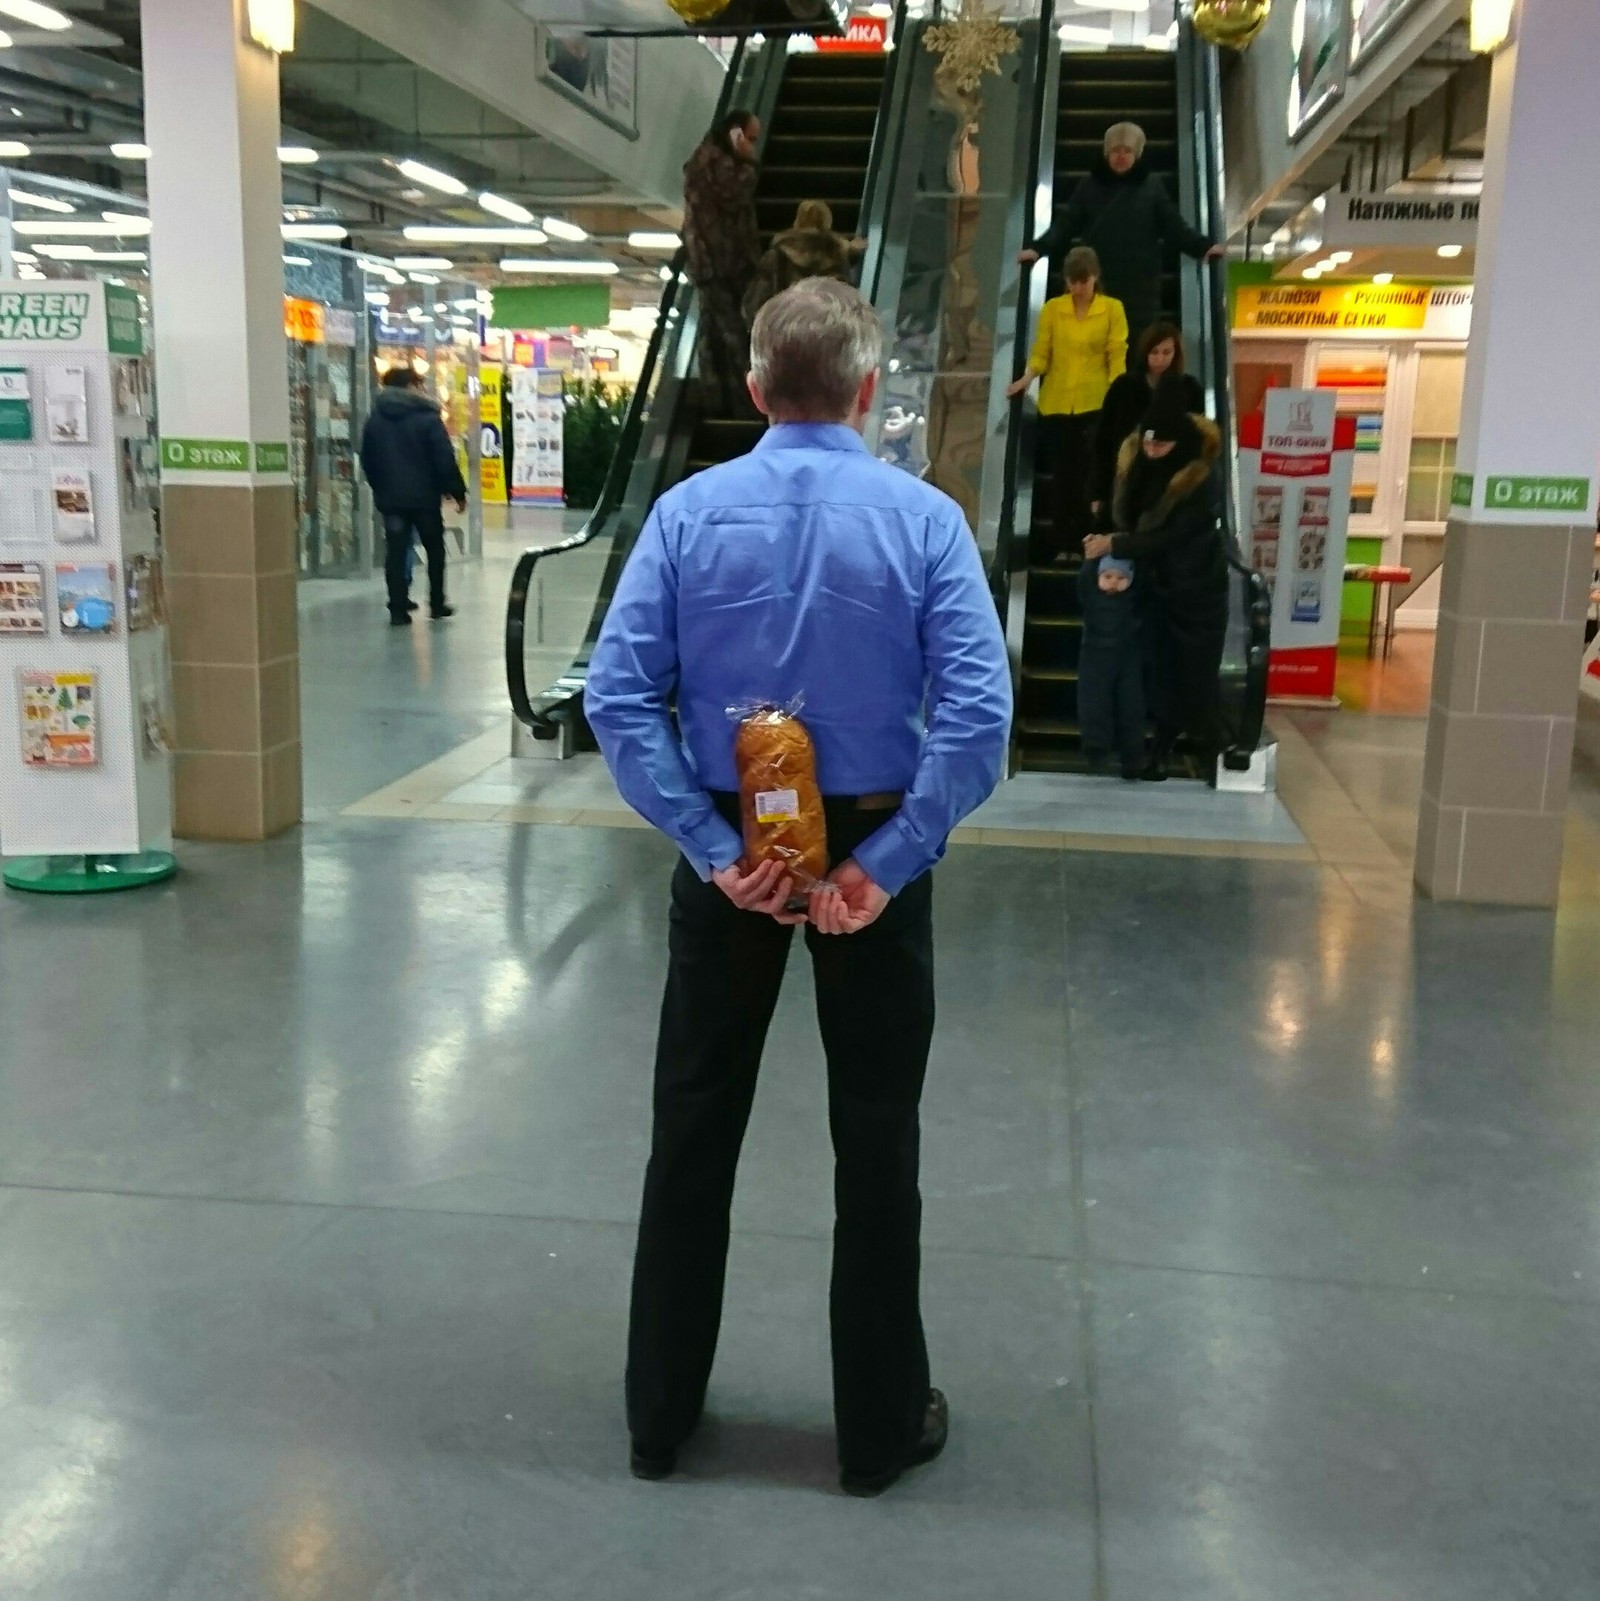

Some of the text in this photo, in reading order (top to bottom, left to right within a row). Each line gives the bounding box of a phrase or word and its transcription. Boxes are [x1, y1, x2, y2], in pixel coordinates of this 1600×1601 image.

[1348, 197, 1455, 221] Натяжные
[0, 292, 90, 318] REEN
[1258, 289, 1322, 305] ЖАЛЮЗИ
[188, 447, 243, 465] этаж
[1518, 485, 1580, 505] этаж
